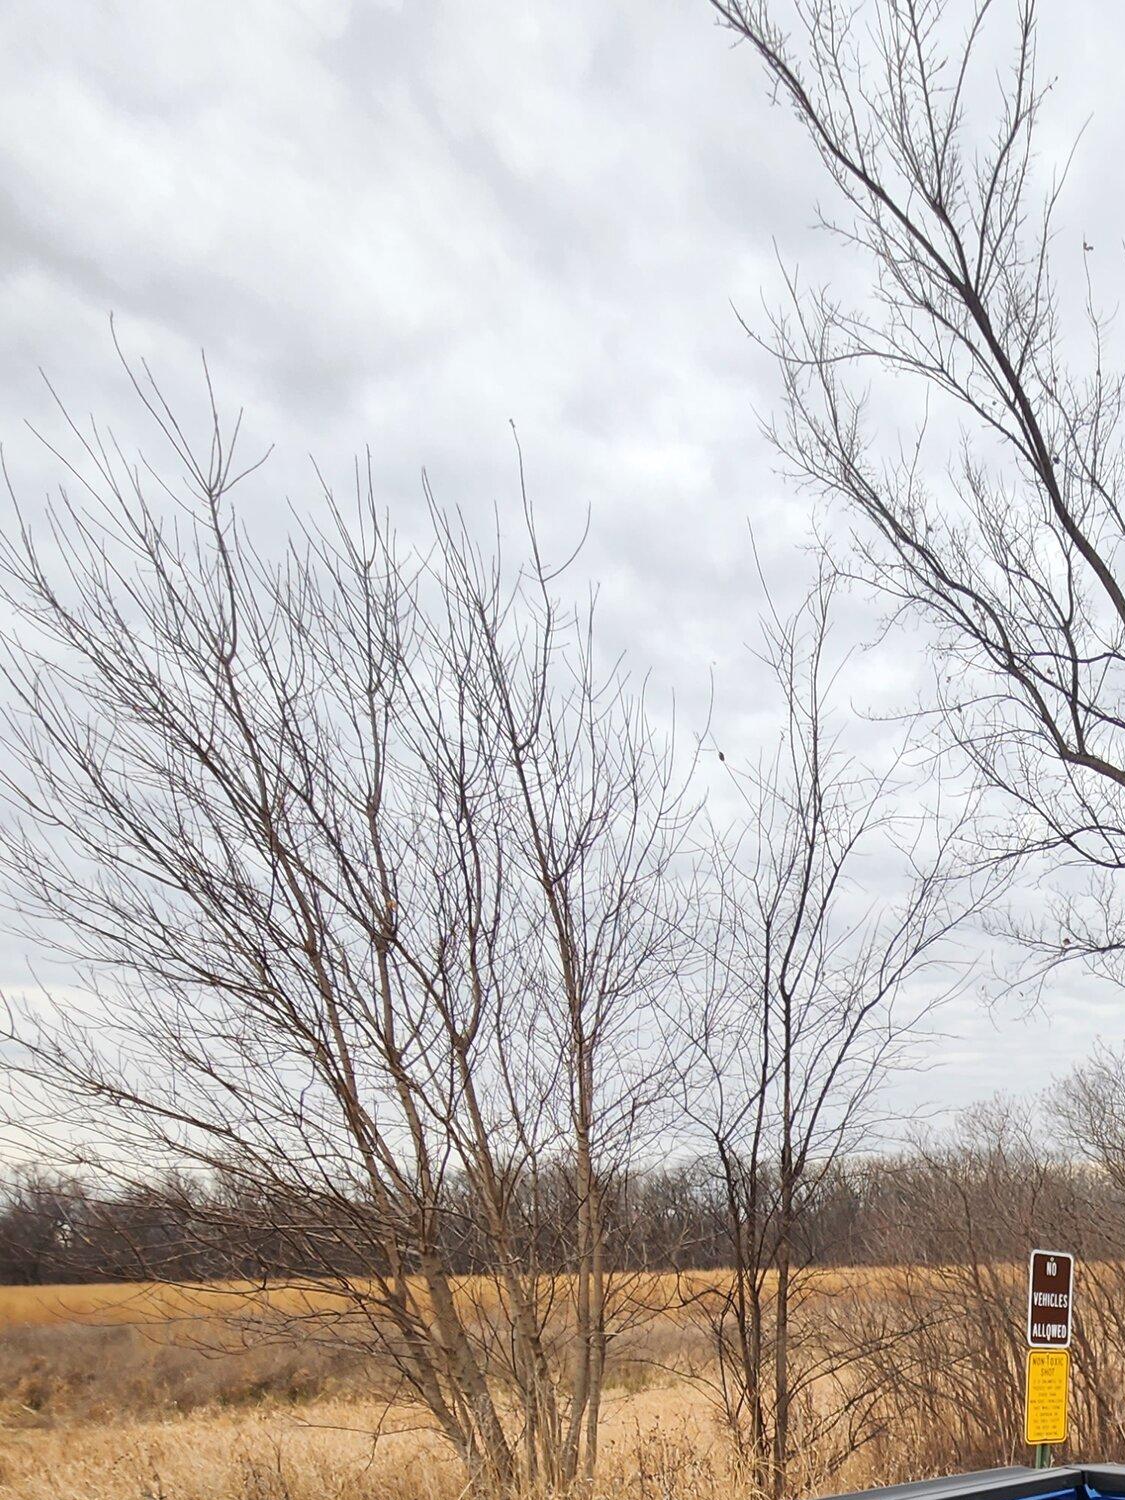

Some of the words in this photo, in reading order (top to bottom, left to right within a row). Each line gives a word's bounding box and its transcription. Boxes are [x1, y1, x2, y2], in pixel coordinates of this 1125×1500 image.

[1046, 1262, 1057, 1276] NO
[1033, 1292, 1068, 1308] VEHICLES
[1032, 1323, 1067, 1339] ALLOWED
[1040, 1367, 1055, 1377] SHOT
